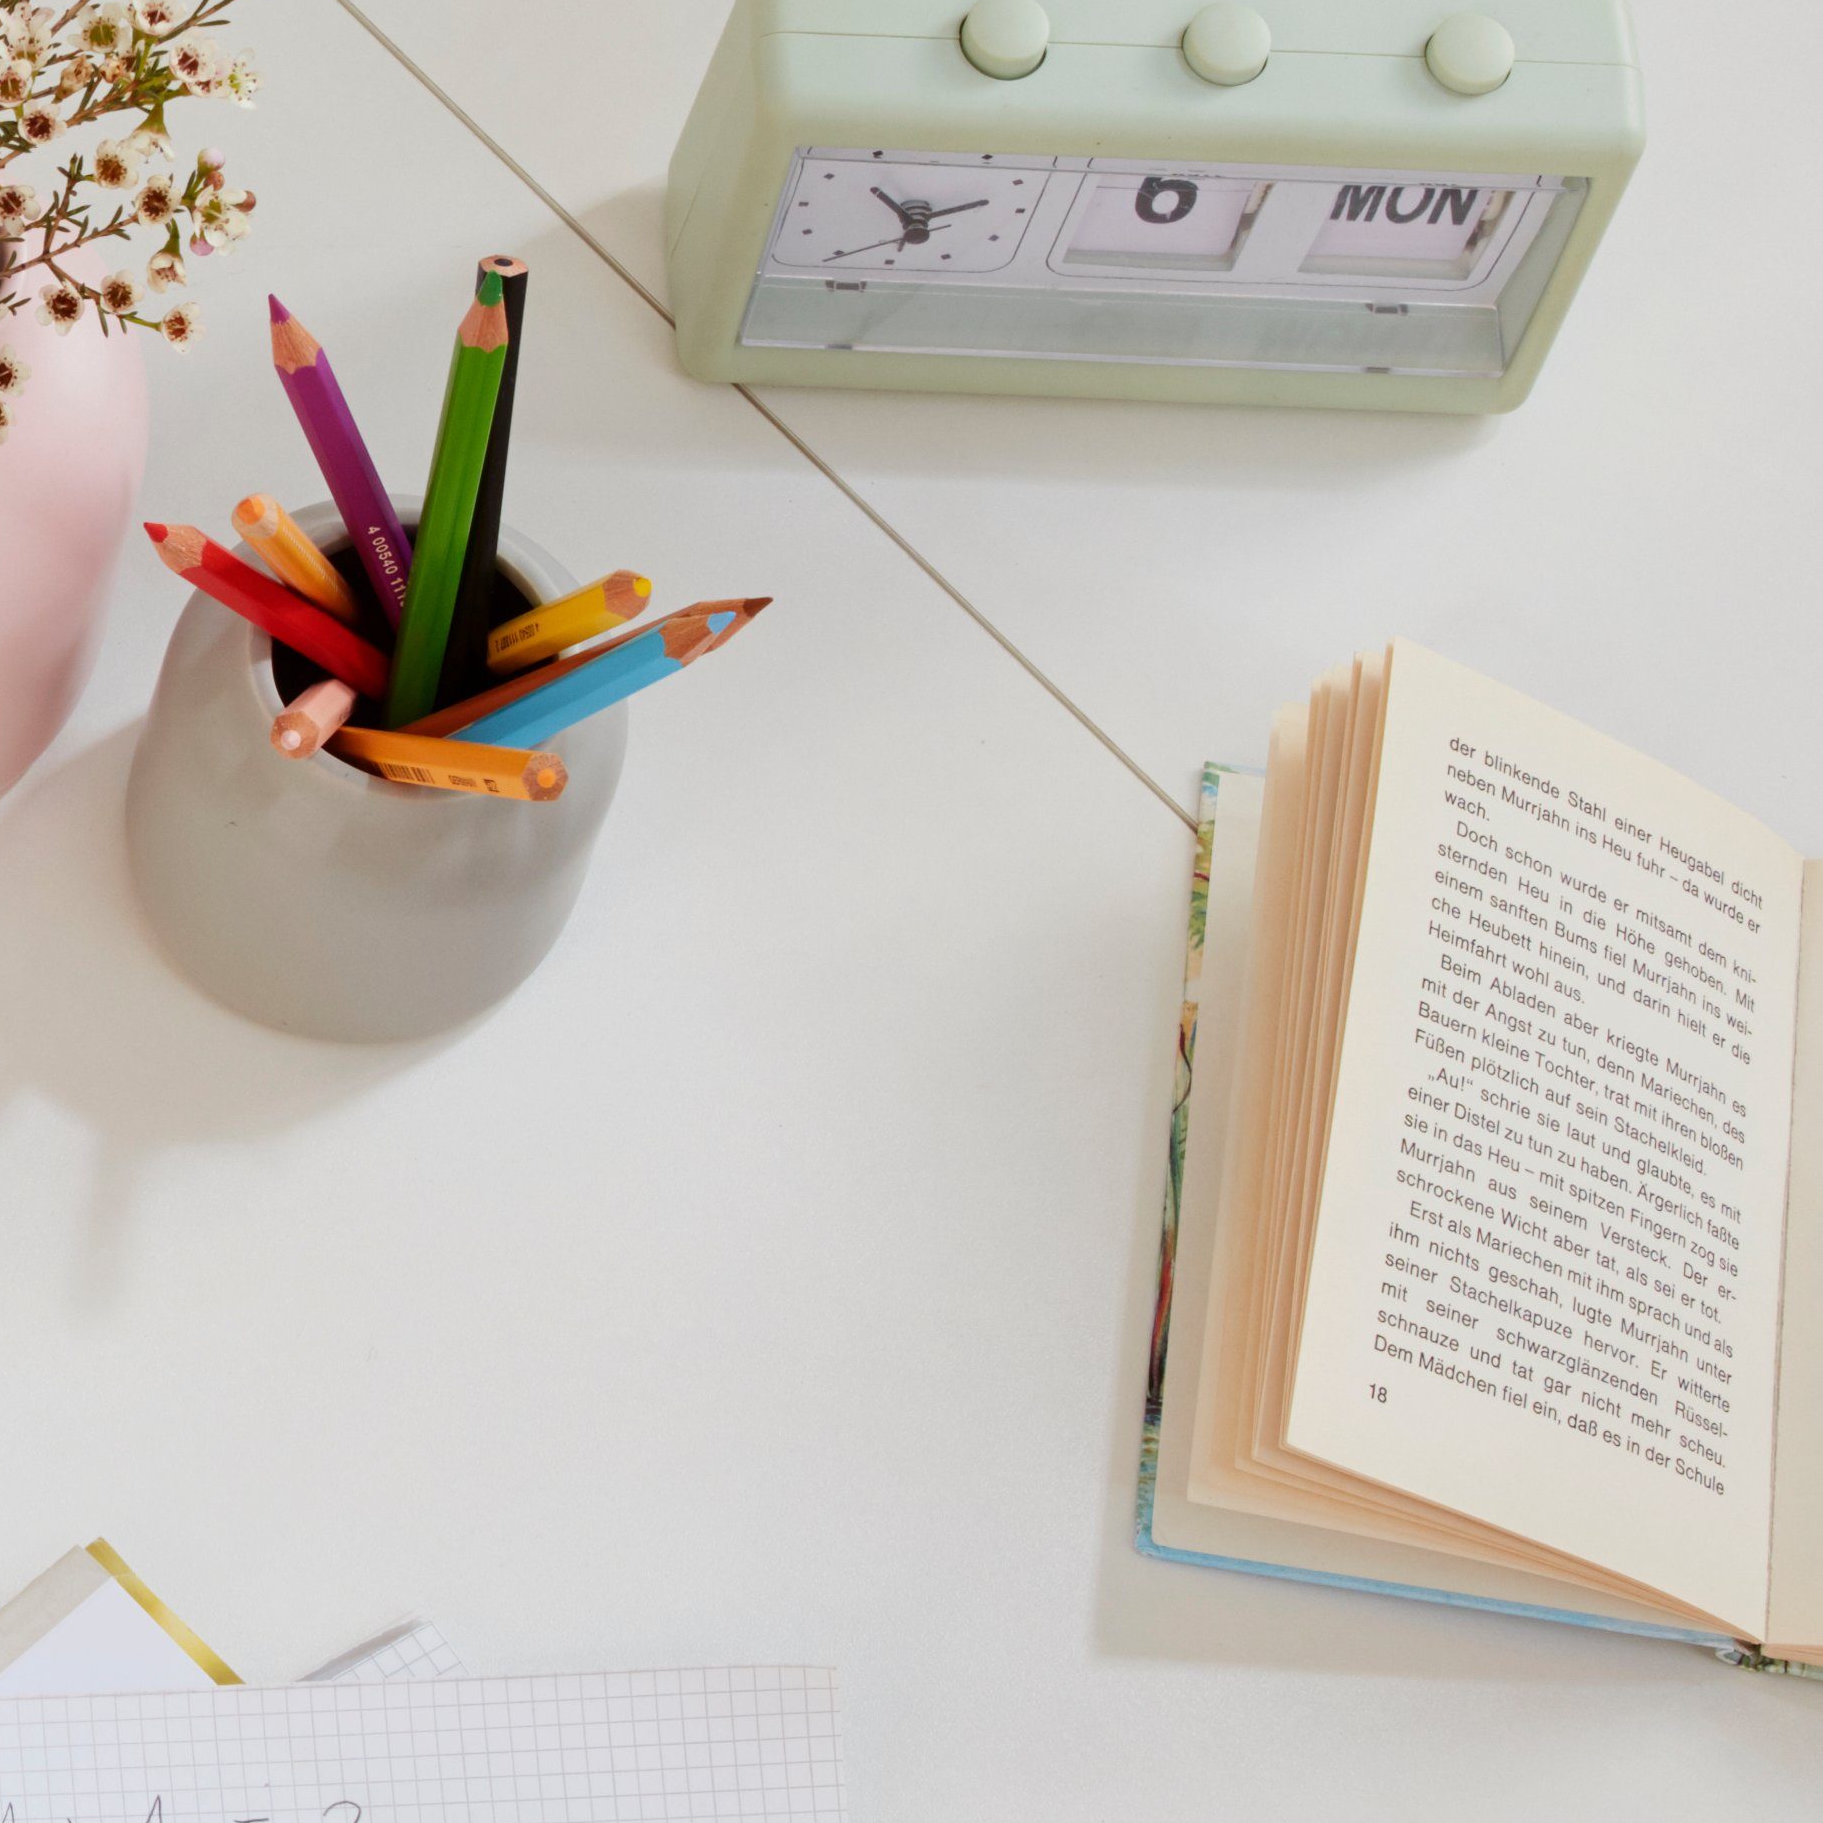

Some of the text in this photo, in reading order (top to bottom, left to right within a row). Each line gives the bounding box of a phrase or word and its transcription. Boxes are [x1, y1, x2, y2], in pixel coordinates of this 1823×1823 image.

[1328, 183, 1479, 227] MON
[367, 526, 381, 535] 4
[372, 536, 399, 575] 00540
[1448, 736, 1764, 911] der blinkende Stahl einer Heugabel dicht
[1427, 919, 1586, 1005] Heimfahrt wohl aus.
[1439, 952, 1748, 1119] Beim Abladen aber kriegte Murrjahn es
[1413, 1026, 1708, 1177] Füßen plötzlich auf sein Stachelkleid.
[1399, 1136, 1738, 1302] Murrjahn aus seinem Versteck. Der er-
[1383, 1252, 1731, 1414] seiner Stachelkapuze hervor. Er witterte
[1369, 1383, 1387, 1404] 18
